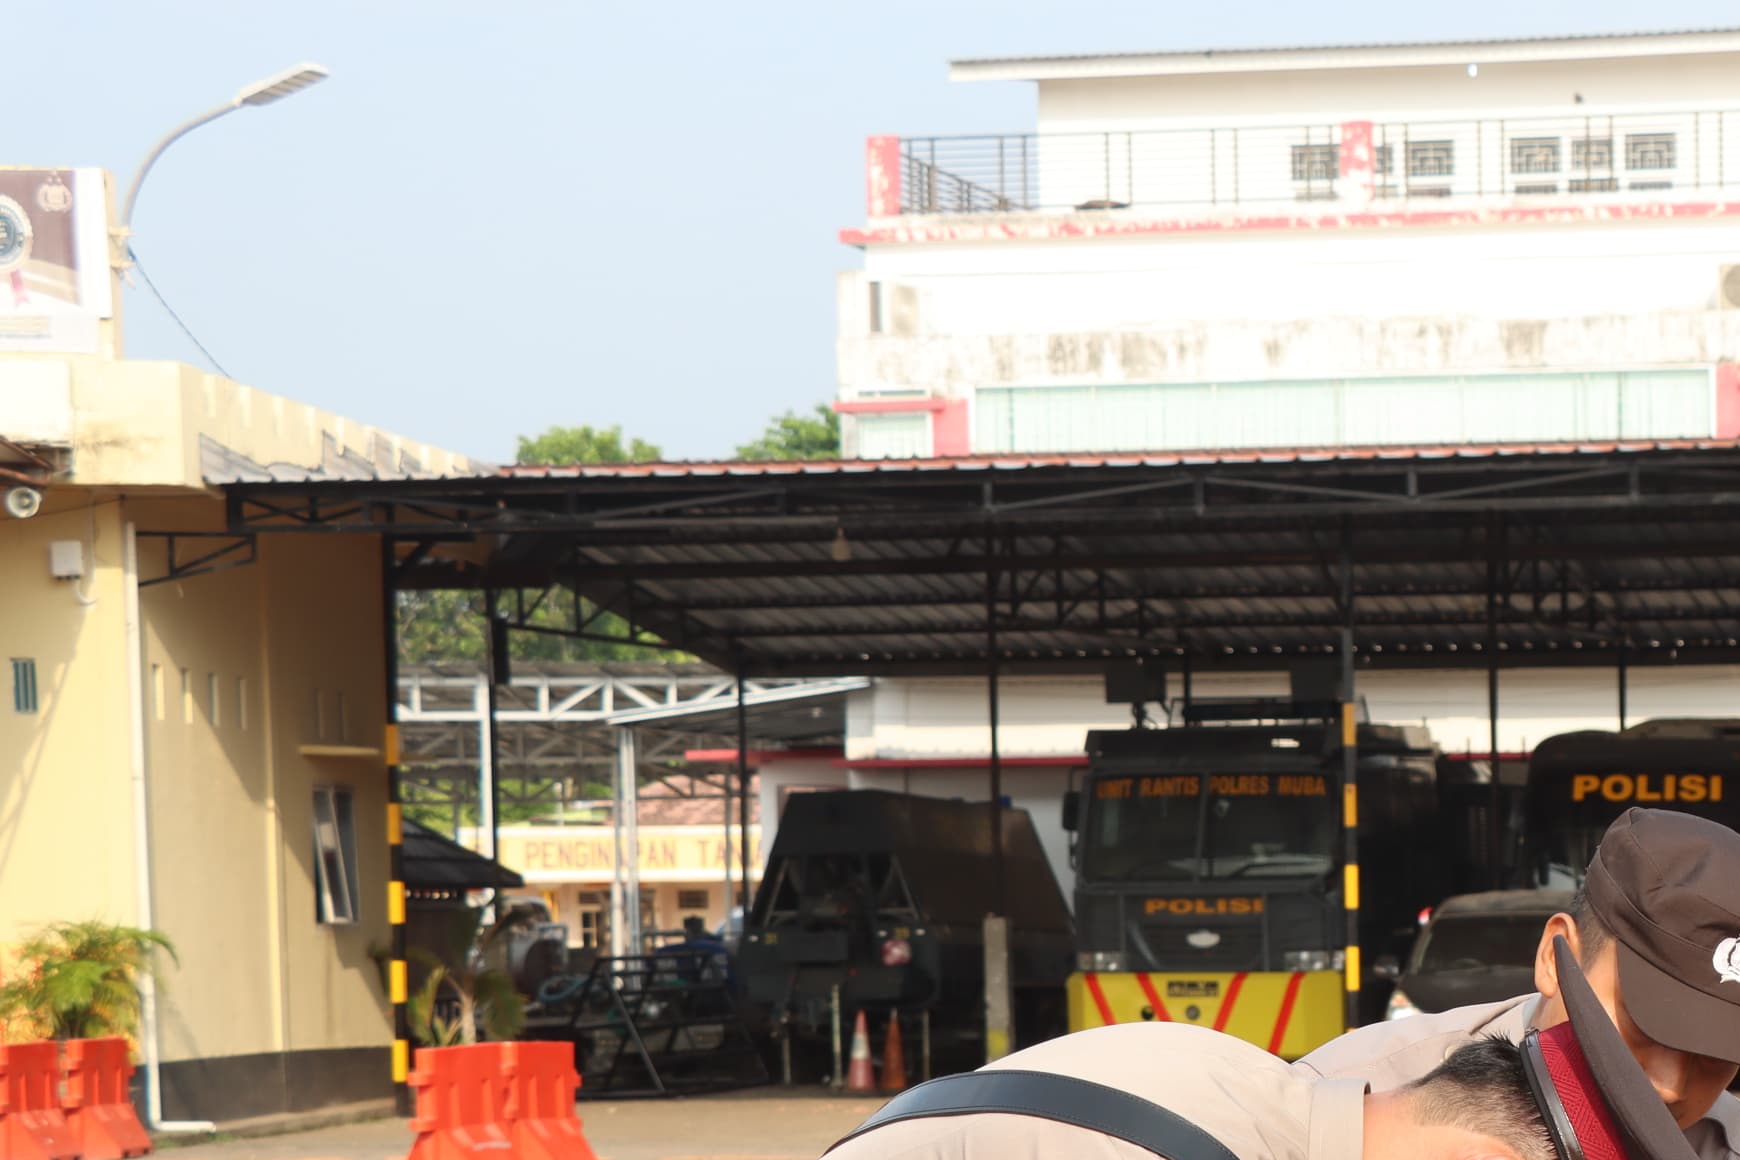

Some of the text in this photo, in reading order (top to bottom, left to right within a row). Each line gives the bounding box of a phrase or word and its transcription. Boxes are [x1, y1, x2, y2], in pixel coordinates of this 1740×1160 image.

[1208, 775, 1269, 796] POLRES
[1277, 775, 1326, 796] MUBA
[1571, 774, 1723, 802] POLISI
[524, 839, 677, 868] PENGINAN
[1144, 897, 1265, 915] POLISI
